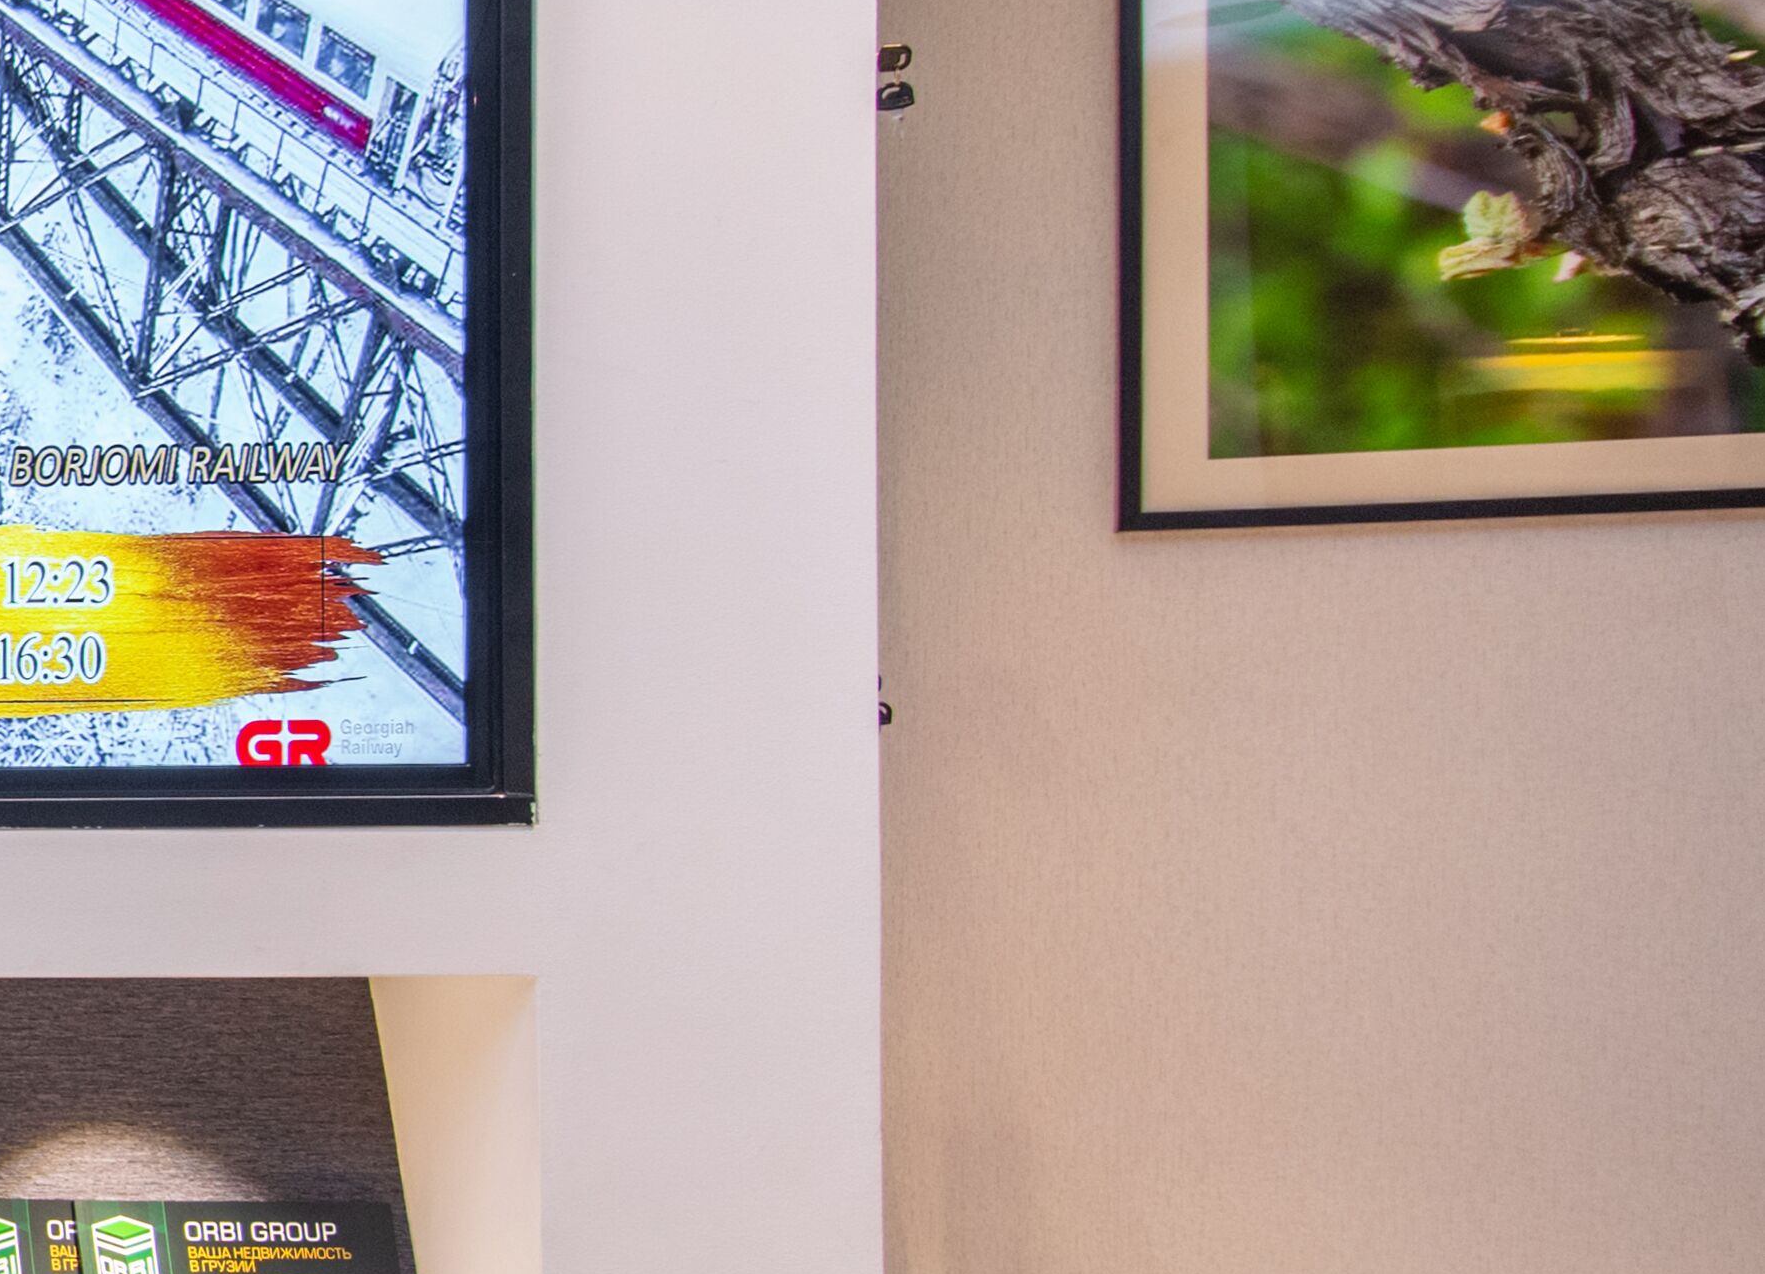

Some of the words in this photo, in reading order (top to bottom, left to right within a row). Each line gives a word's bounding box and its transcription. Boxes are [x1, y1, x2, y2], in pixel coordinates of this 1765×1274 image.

[9, 443, 180, 487] BORJOMI
[187, 441, 350, 484] RAILWAY
[3, 555, 114, 608] 12:23
[235, 719, 331, 765] GR
[340, 740, 402, 758] Railway
[184, 1221, 243, 1242] ORBI
[251, 1221, 337, 1242] GROUP
[187, 1246, 231, 1259] ВАША
[233, 1246, 352, 1261] НЕДВИЖИМОСТЬ
[190, 1260, 199, 1272] В
[201, 1260, 256, 1273] ГРУЗИИ
